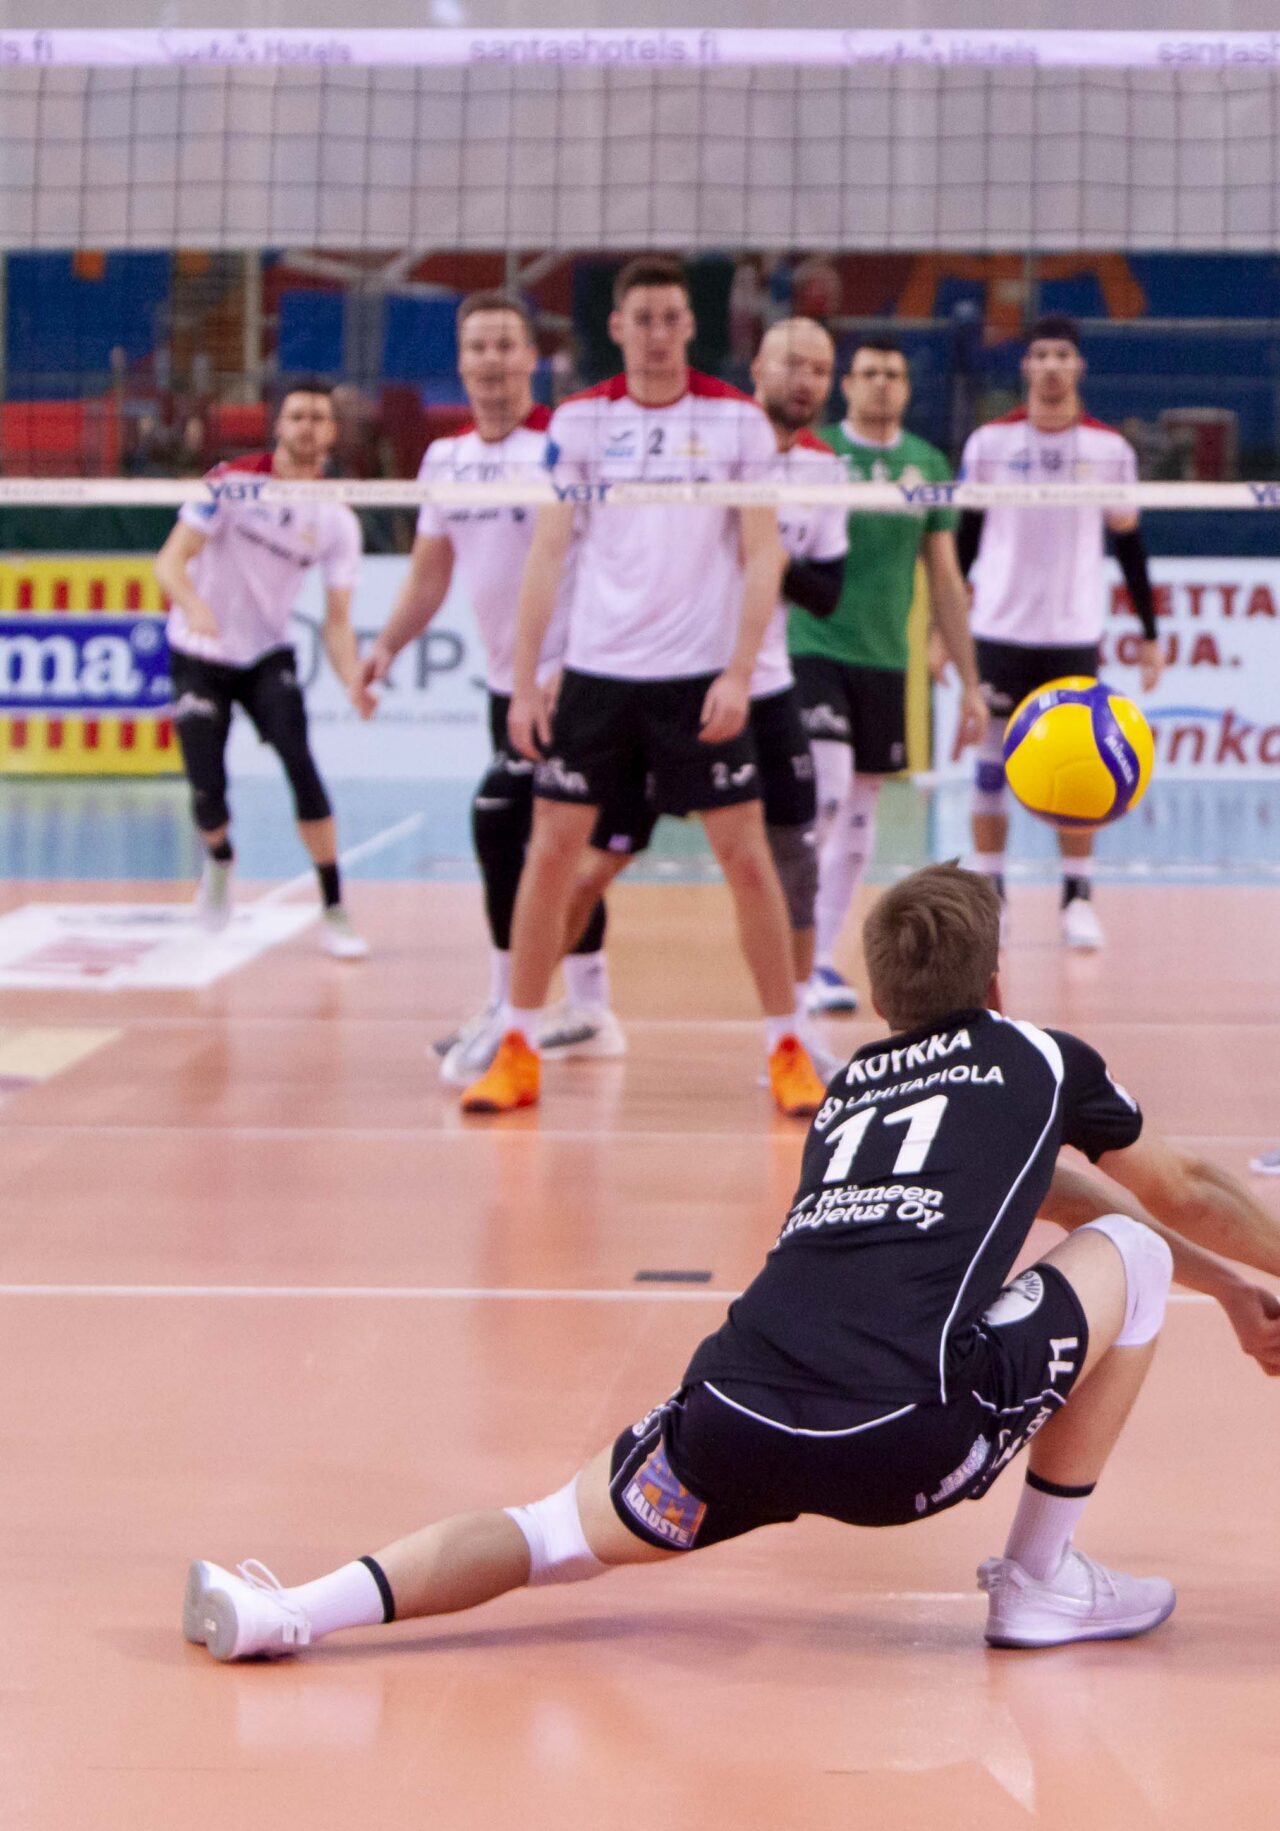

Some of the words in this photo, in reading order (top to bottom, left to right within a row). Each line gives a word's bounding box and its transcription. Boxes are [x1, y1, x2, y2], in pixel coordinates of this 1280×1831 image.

[822, 1094, 949, 1184] 11
[818, 1184, 944, 1208] Hämeen
[896, 1201, 945, 1230] Oy
[624, 1482, 691, 1545] KALUSTE
